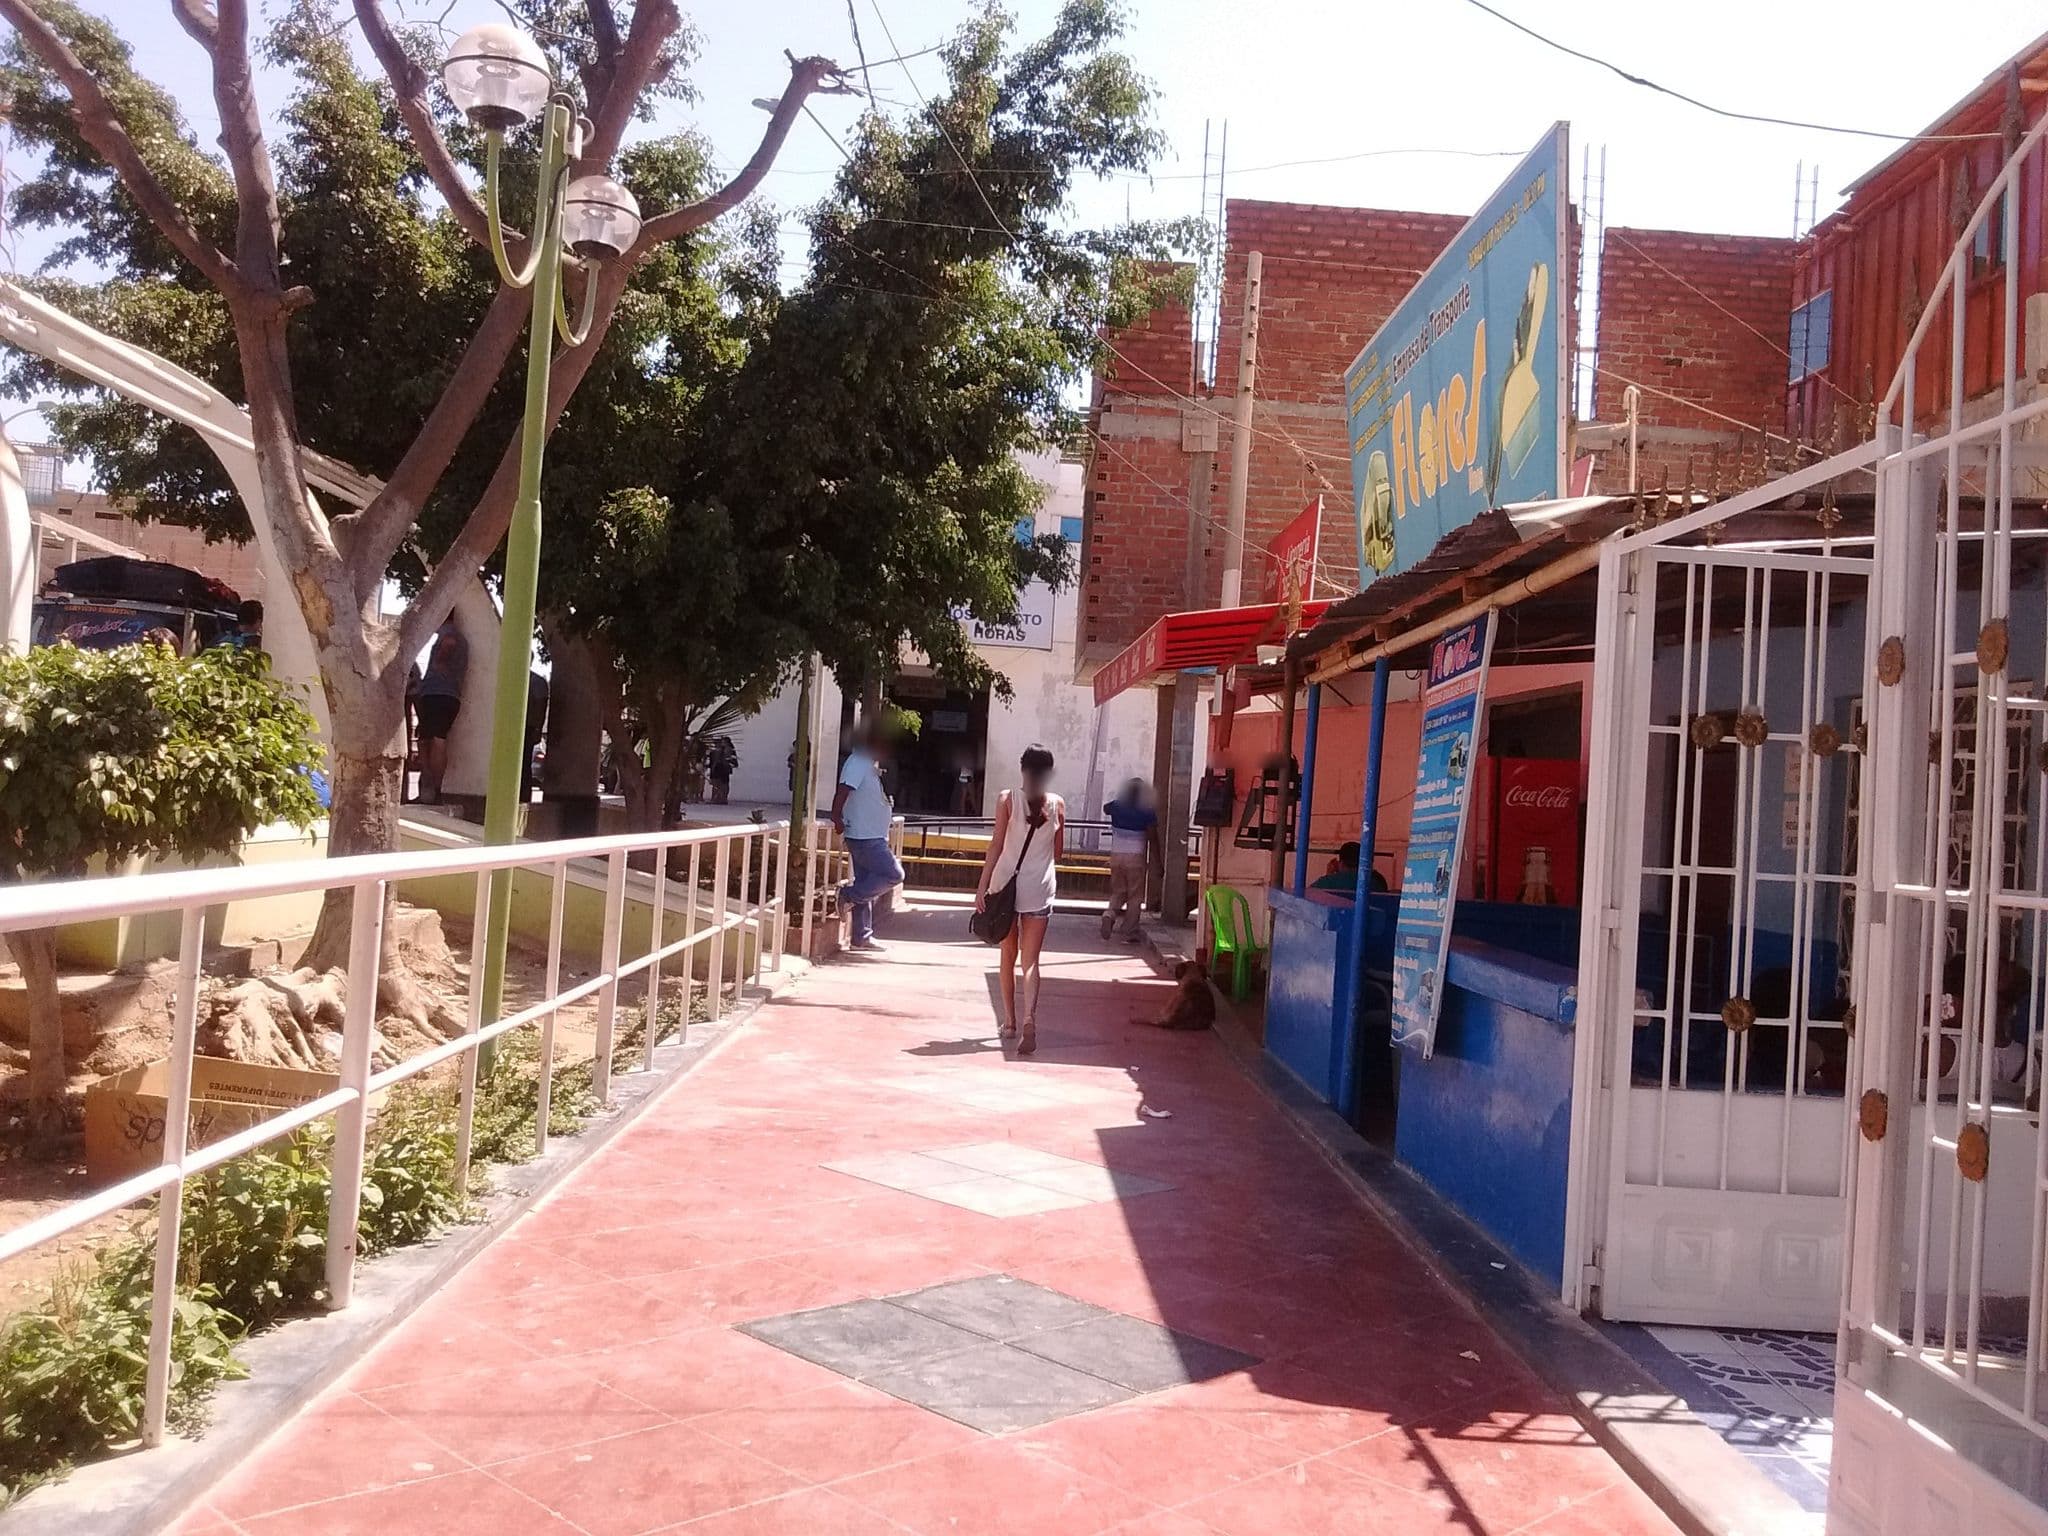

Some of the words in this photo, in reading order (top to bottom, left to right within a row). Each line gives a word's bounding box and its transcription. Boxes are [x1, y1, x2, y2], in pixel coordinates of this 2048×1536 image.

[1392, 353, 1420, 385] Empresa
[1421, 322, 1430, 355] de
[1429, 281, 1470, 346] Transporte
[1392, 318, 1487, 519] Flores
[974, 626, 1026, 642] HORAS
[208, 1081, 263, 1097] DIFERENTES
